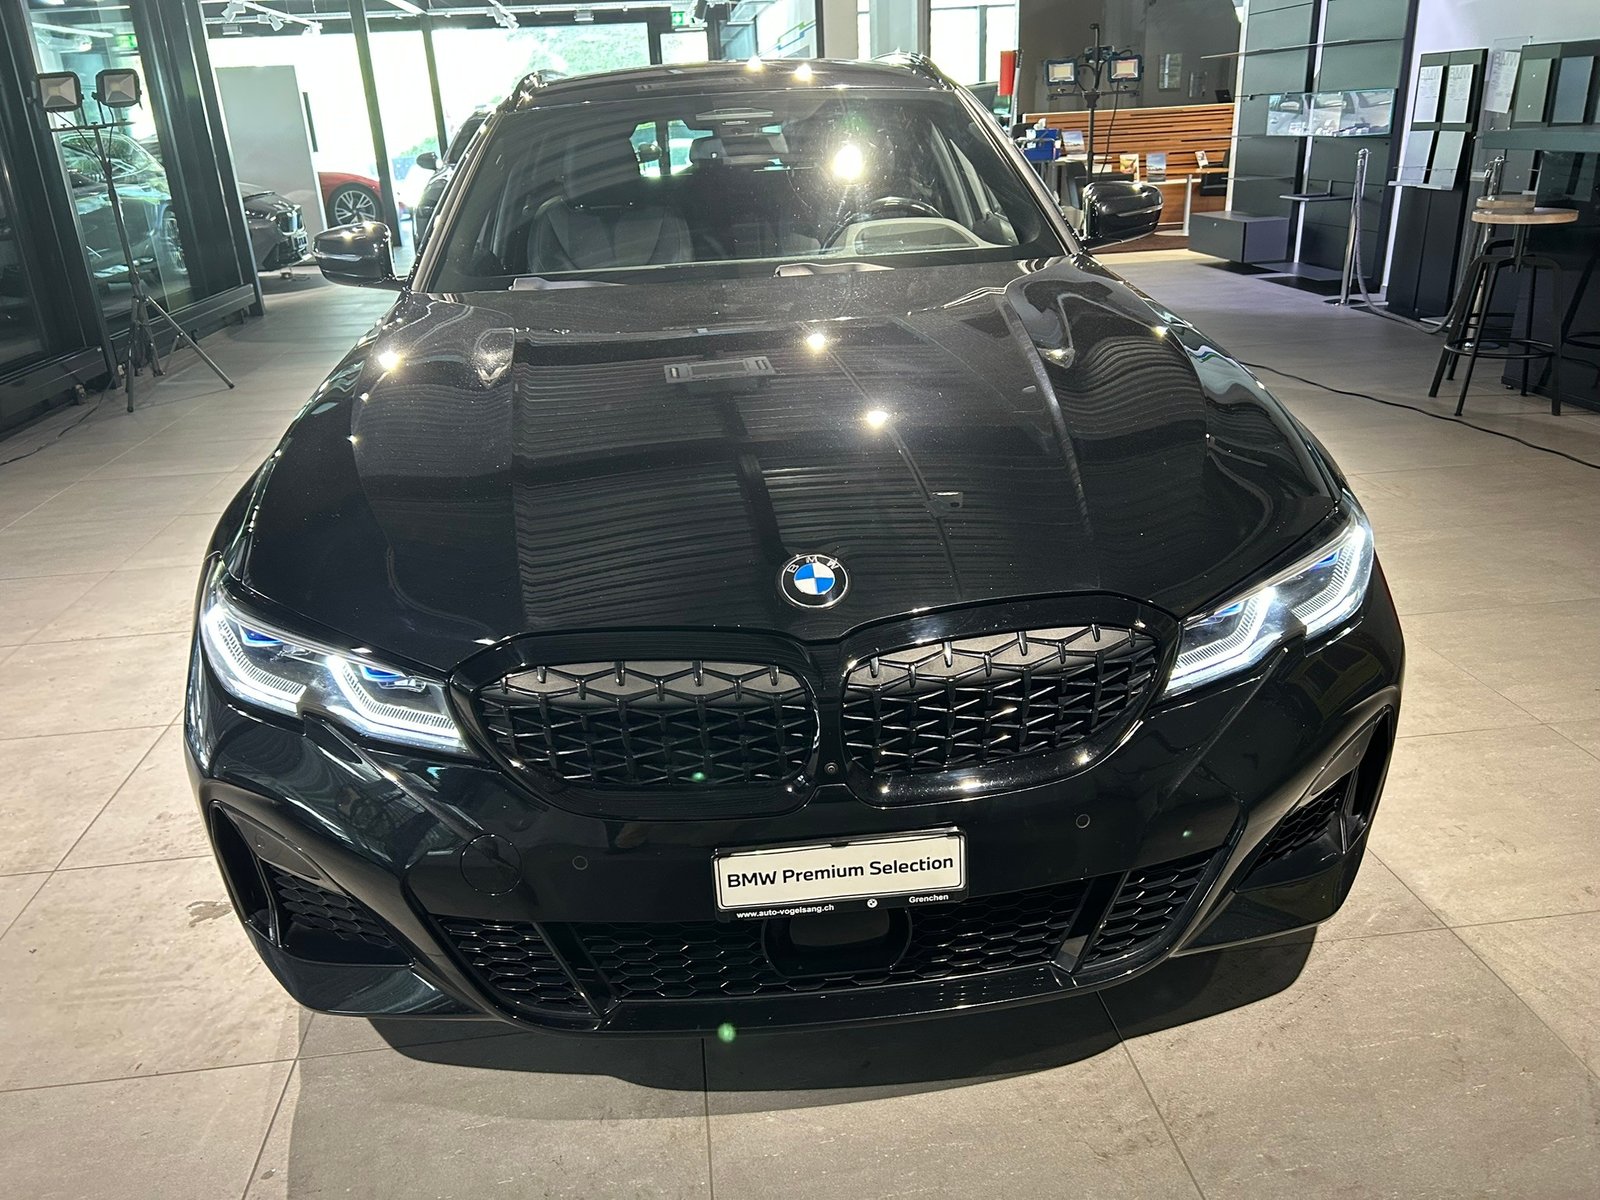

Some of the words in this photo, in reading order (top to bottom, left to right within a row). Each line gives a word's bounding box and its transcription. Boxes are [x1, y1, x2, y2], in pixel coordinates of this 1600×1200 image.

[786, 555, 840, 574] BMW
[727, 871, 777, 888] BMW
[782, 864, 864, 884] Premium
[869, 857, 954, 876] Selection
[908, 893, 949, 904] Grenchen
[736, 904, 835, 919] www.auto-vogelsang.ch
